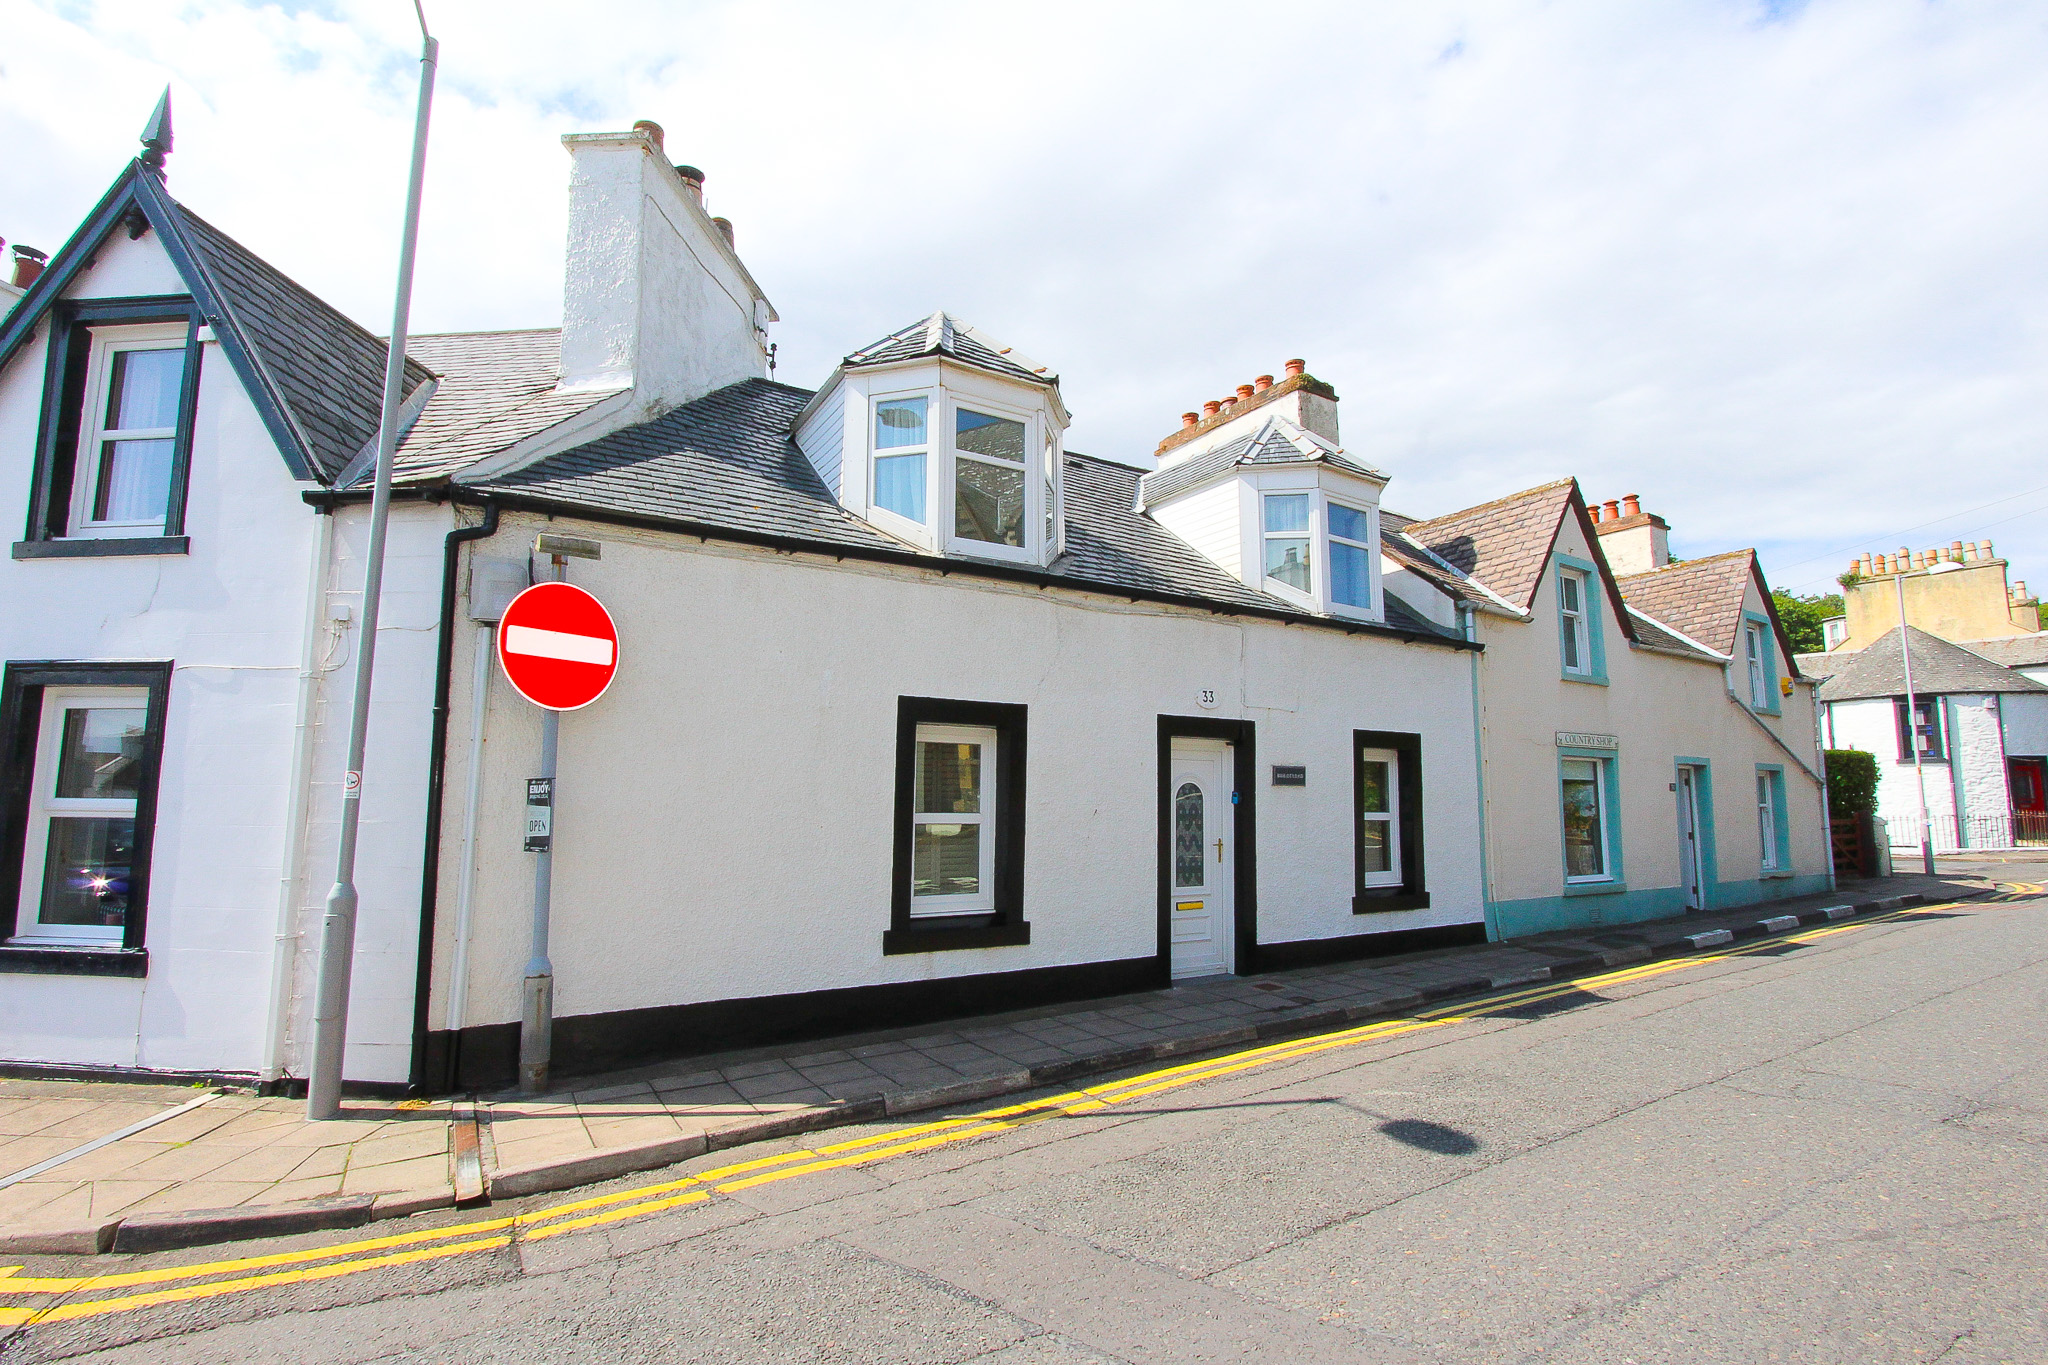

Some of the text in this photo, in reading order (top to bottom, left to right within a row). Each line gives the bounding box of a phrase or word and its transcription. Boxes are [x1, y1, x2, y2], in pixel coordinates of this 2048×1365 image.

[1202, 690, 1215, 703] 33
[1564, 734, 1613, 746] COUNTRY SHOP
[529, 784, 549, 794] ENJOY
[529, 820, 547, 832] OPEN
